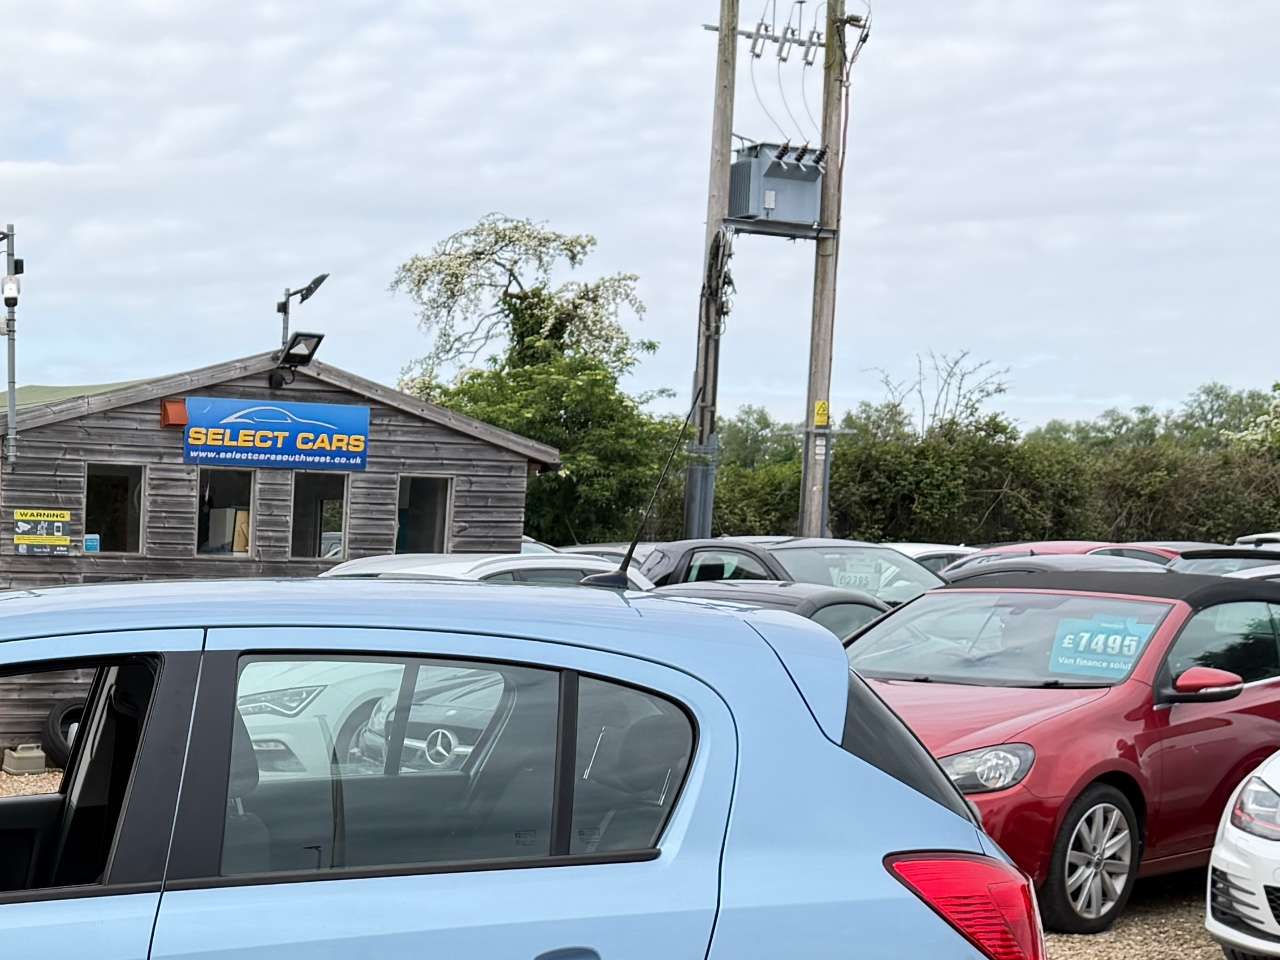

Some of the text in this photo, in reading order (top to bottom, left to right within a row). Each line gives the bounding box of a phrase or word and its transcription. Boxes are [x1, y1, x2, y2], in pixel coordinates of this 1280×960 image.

[188, 427, 366, 452] SELECT CARS
[19, 511, 65, 519] WARNING
[1076, 657, 1108, 668] finance
